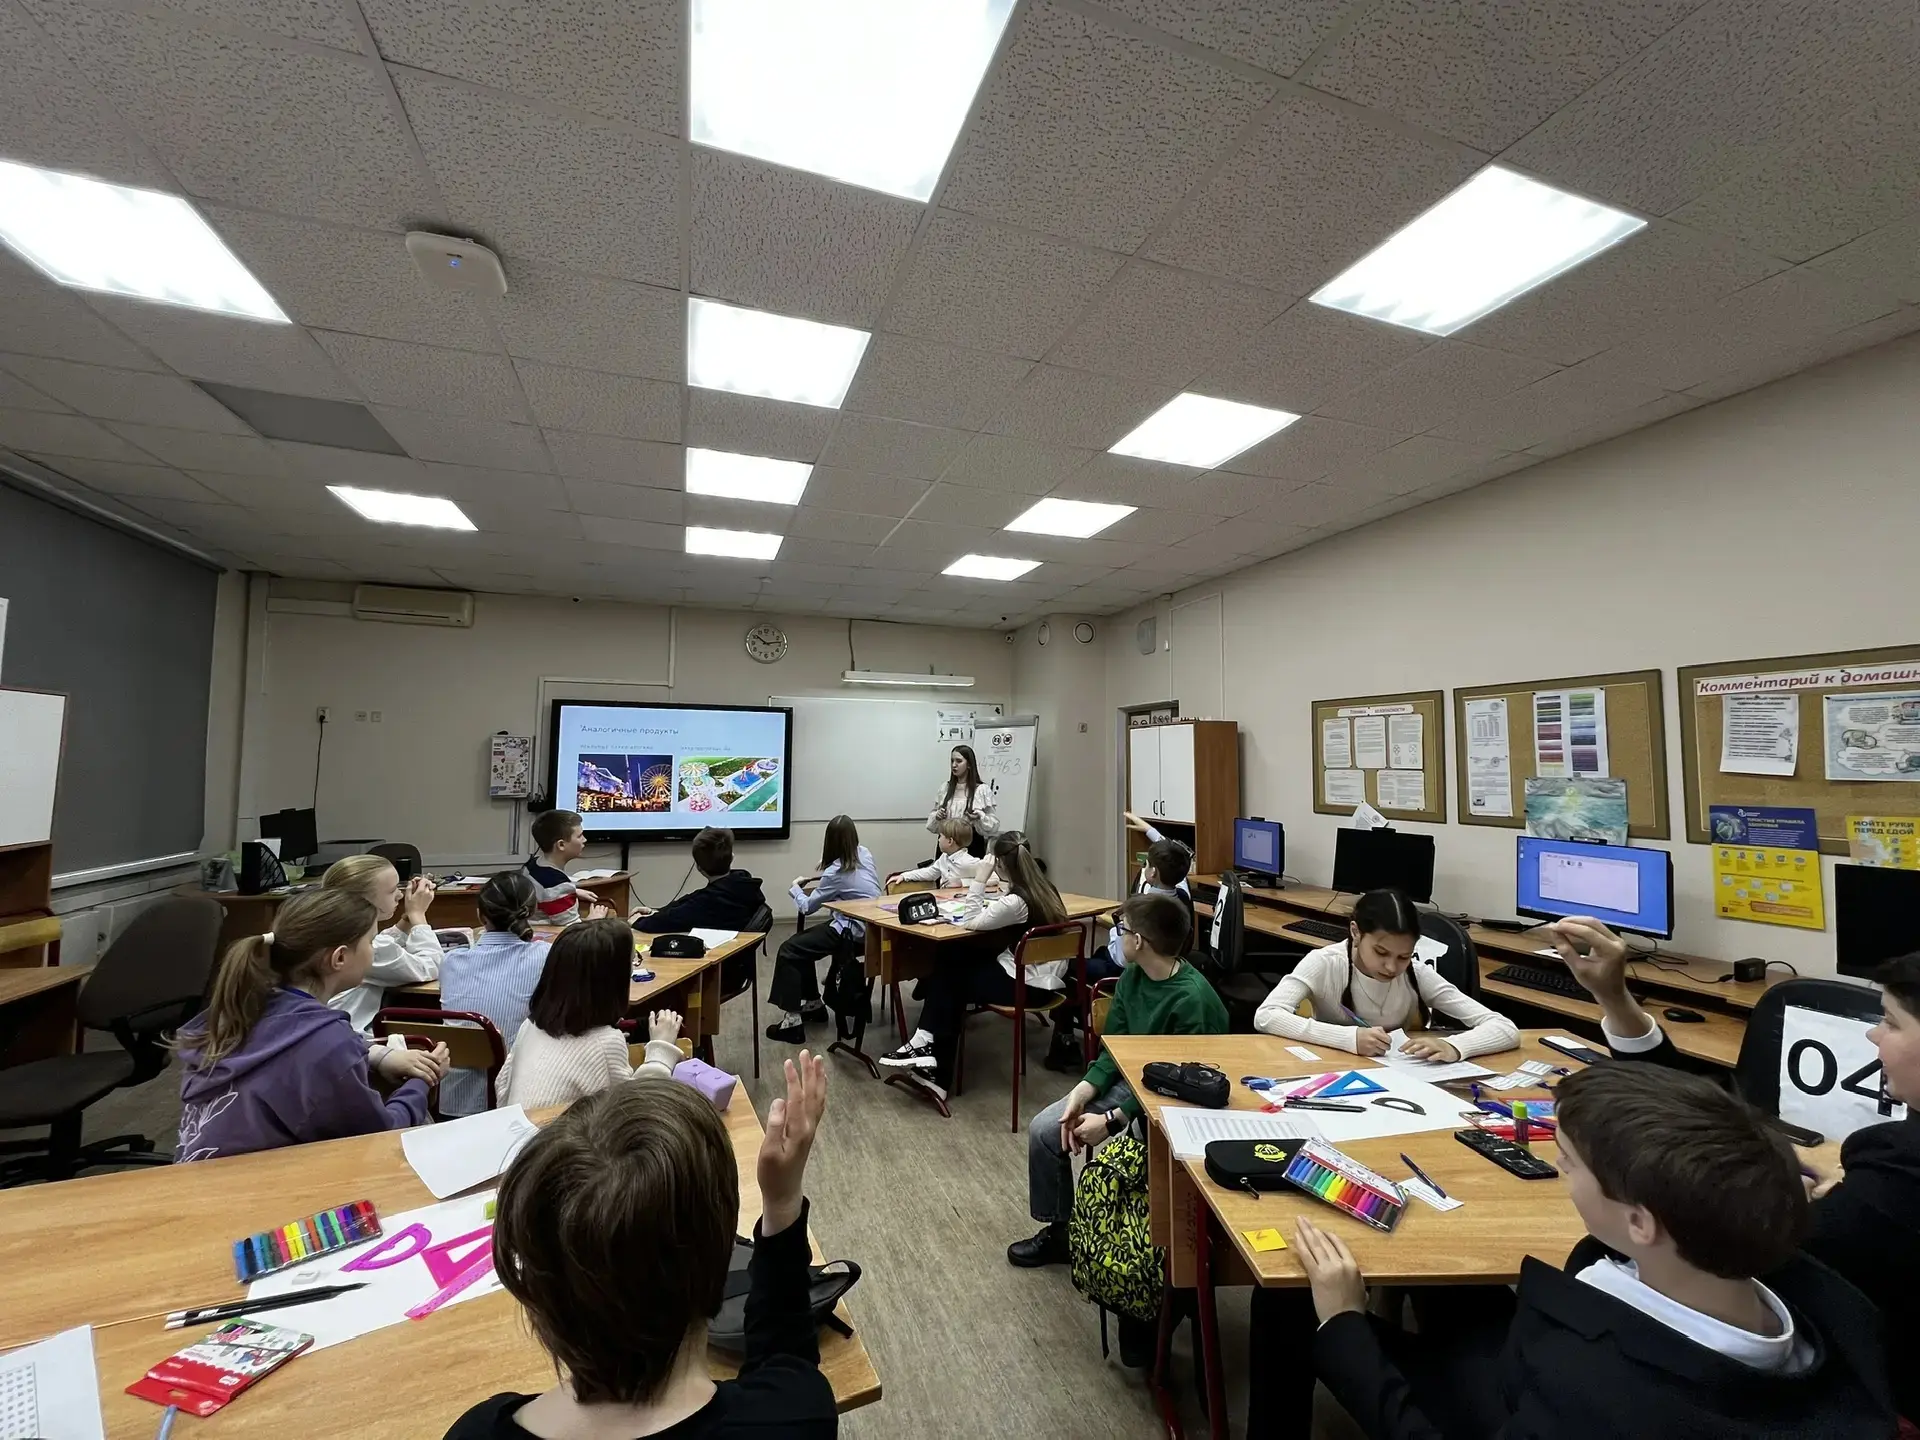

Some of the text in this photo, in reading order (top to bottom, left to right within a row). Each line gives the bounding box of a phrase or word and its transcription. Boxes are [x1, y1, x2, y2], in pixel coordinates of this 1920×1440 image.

[1699, 673, 1820, 693] Комментарий
[1824, 675, 1836, 684] к
[1788, 1039, 1903, 1117] 04
